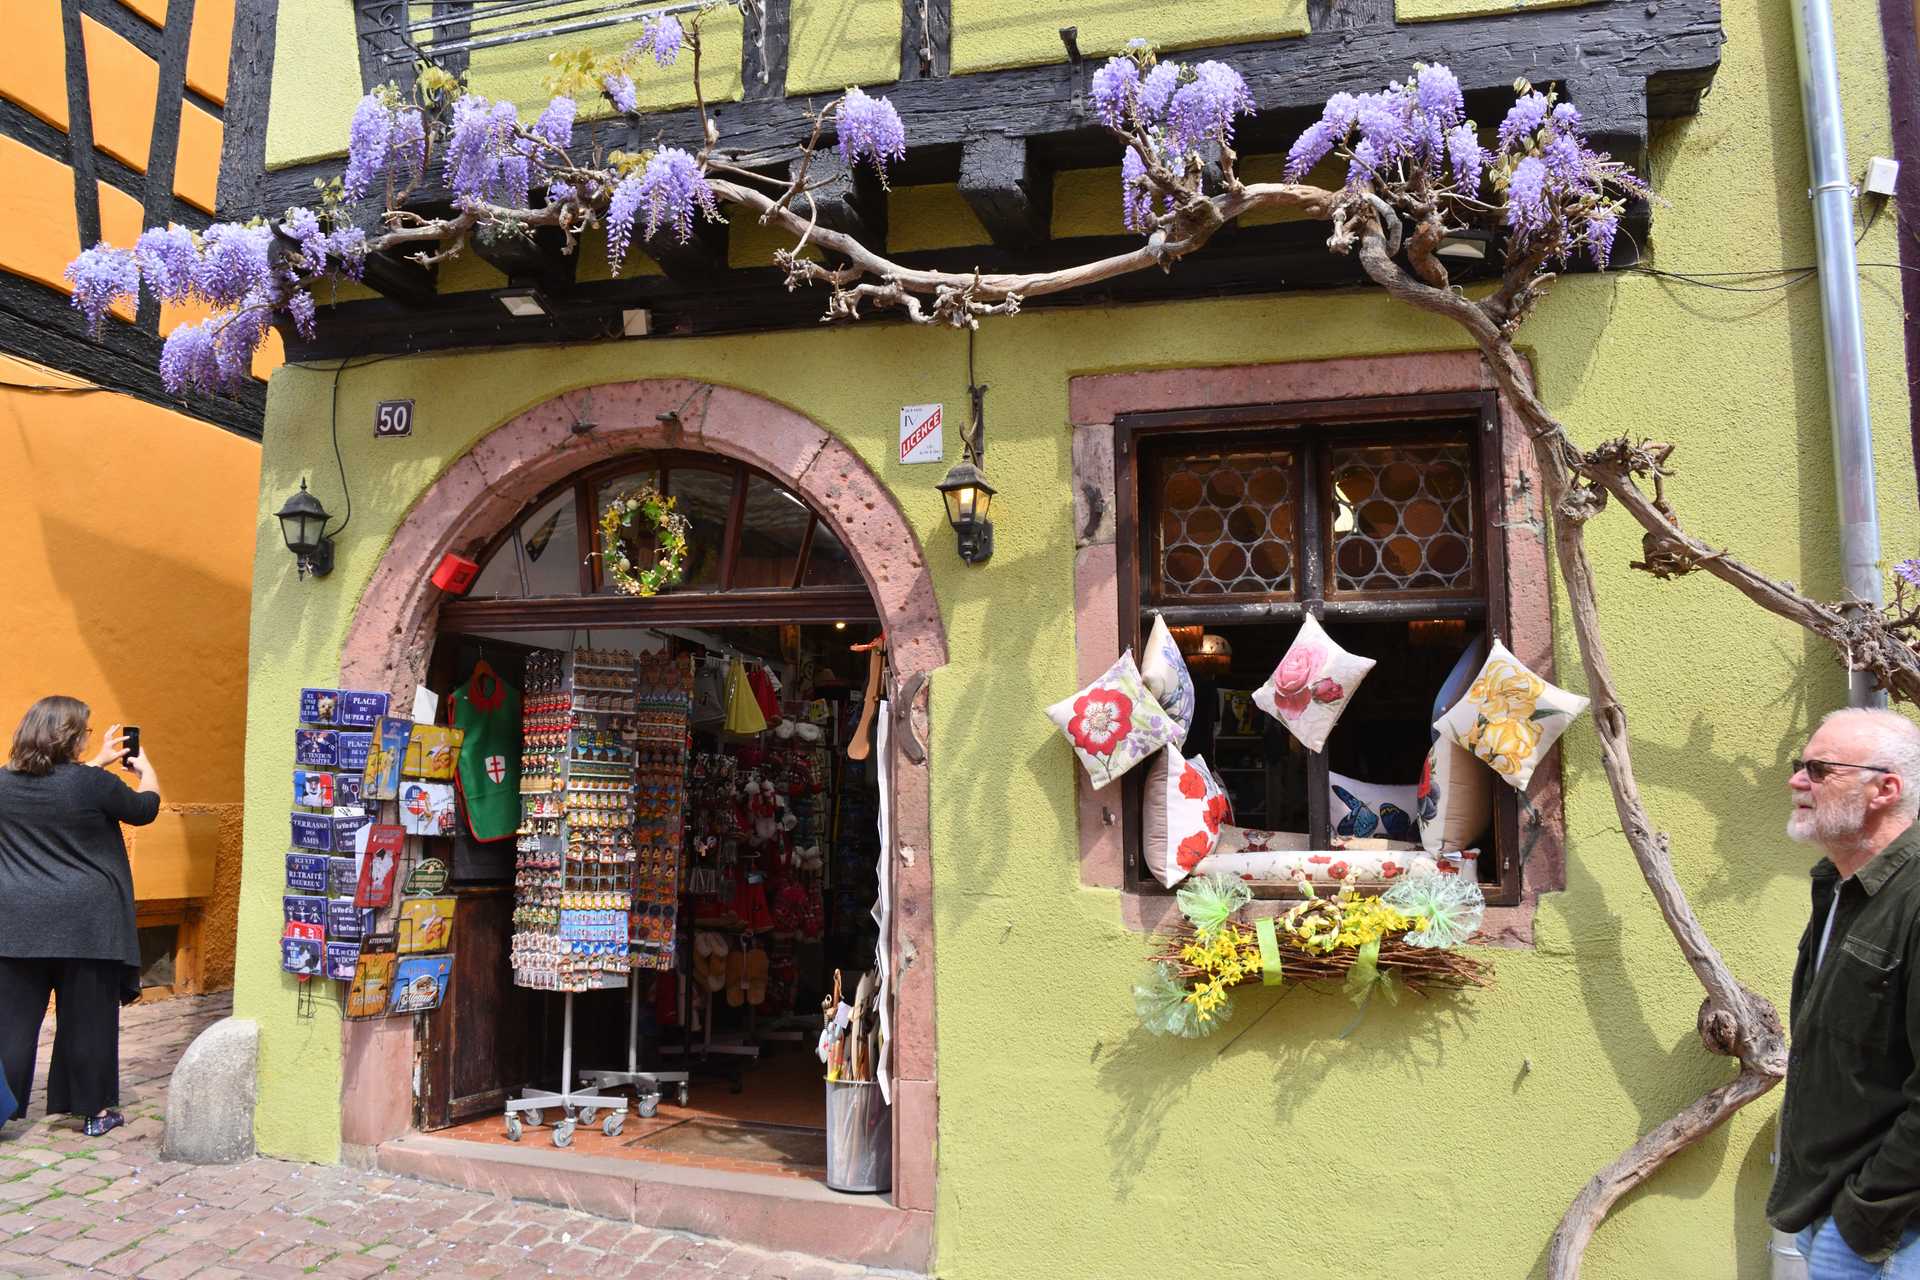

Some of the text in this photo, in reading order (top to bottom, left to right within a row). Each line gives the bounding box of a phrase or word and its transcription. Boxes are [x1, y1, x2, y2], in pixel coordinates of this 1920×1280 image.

[380, 406, 407, 432] 50
[902, 412, 941, 455] LICENCE
[353, 697, 376, 705] PLACE
[303, 751, 332, 759] ATTENTION
[293, 820, 327, 829] TERRASSE
[303, 837, 319, 845] AMIS
[291, 879, 320, 888] HEUREUX
